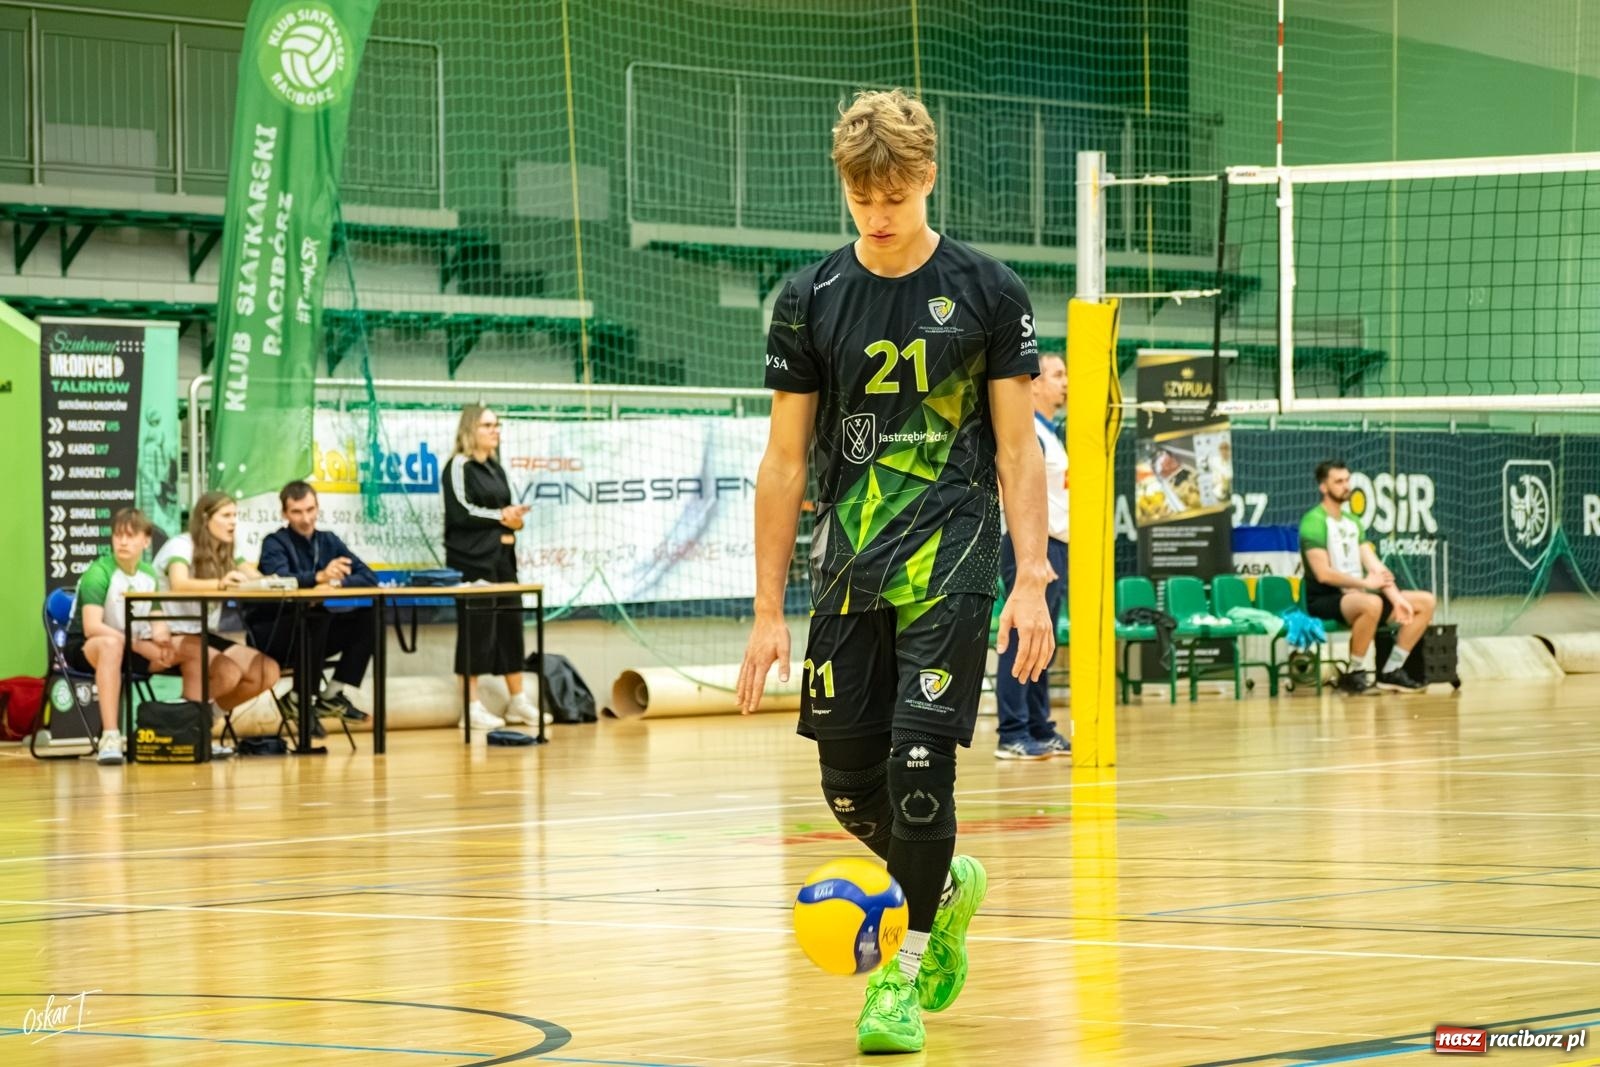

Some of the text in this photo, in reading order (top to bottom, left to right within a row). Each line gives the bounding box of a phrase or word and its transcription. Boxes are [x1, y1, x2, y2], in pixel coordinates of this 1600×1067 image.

[224, 123, 278, 411] KLUB SIATKARSKI
[262, 191, 293, 357] RACIBÓRZ
[1021, 314, 1036, 338] S
[49, 354, 113, 378] MŁODYCH
[864, 339, 929, 395] 21
[513, 477, 704, 504] VANESSA
[803, 658, 835, 698] 21
